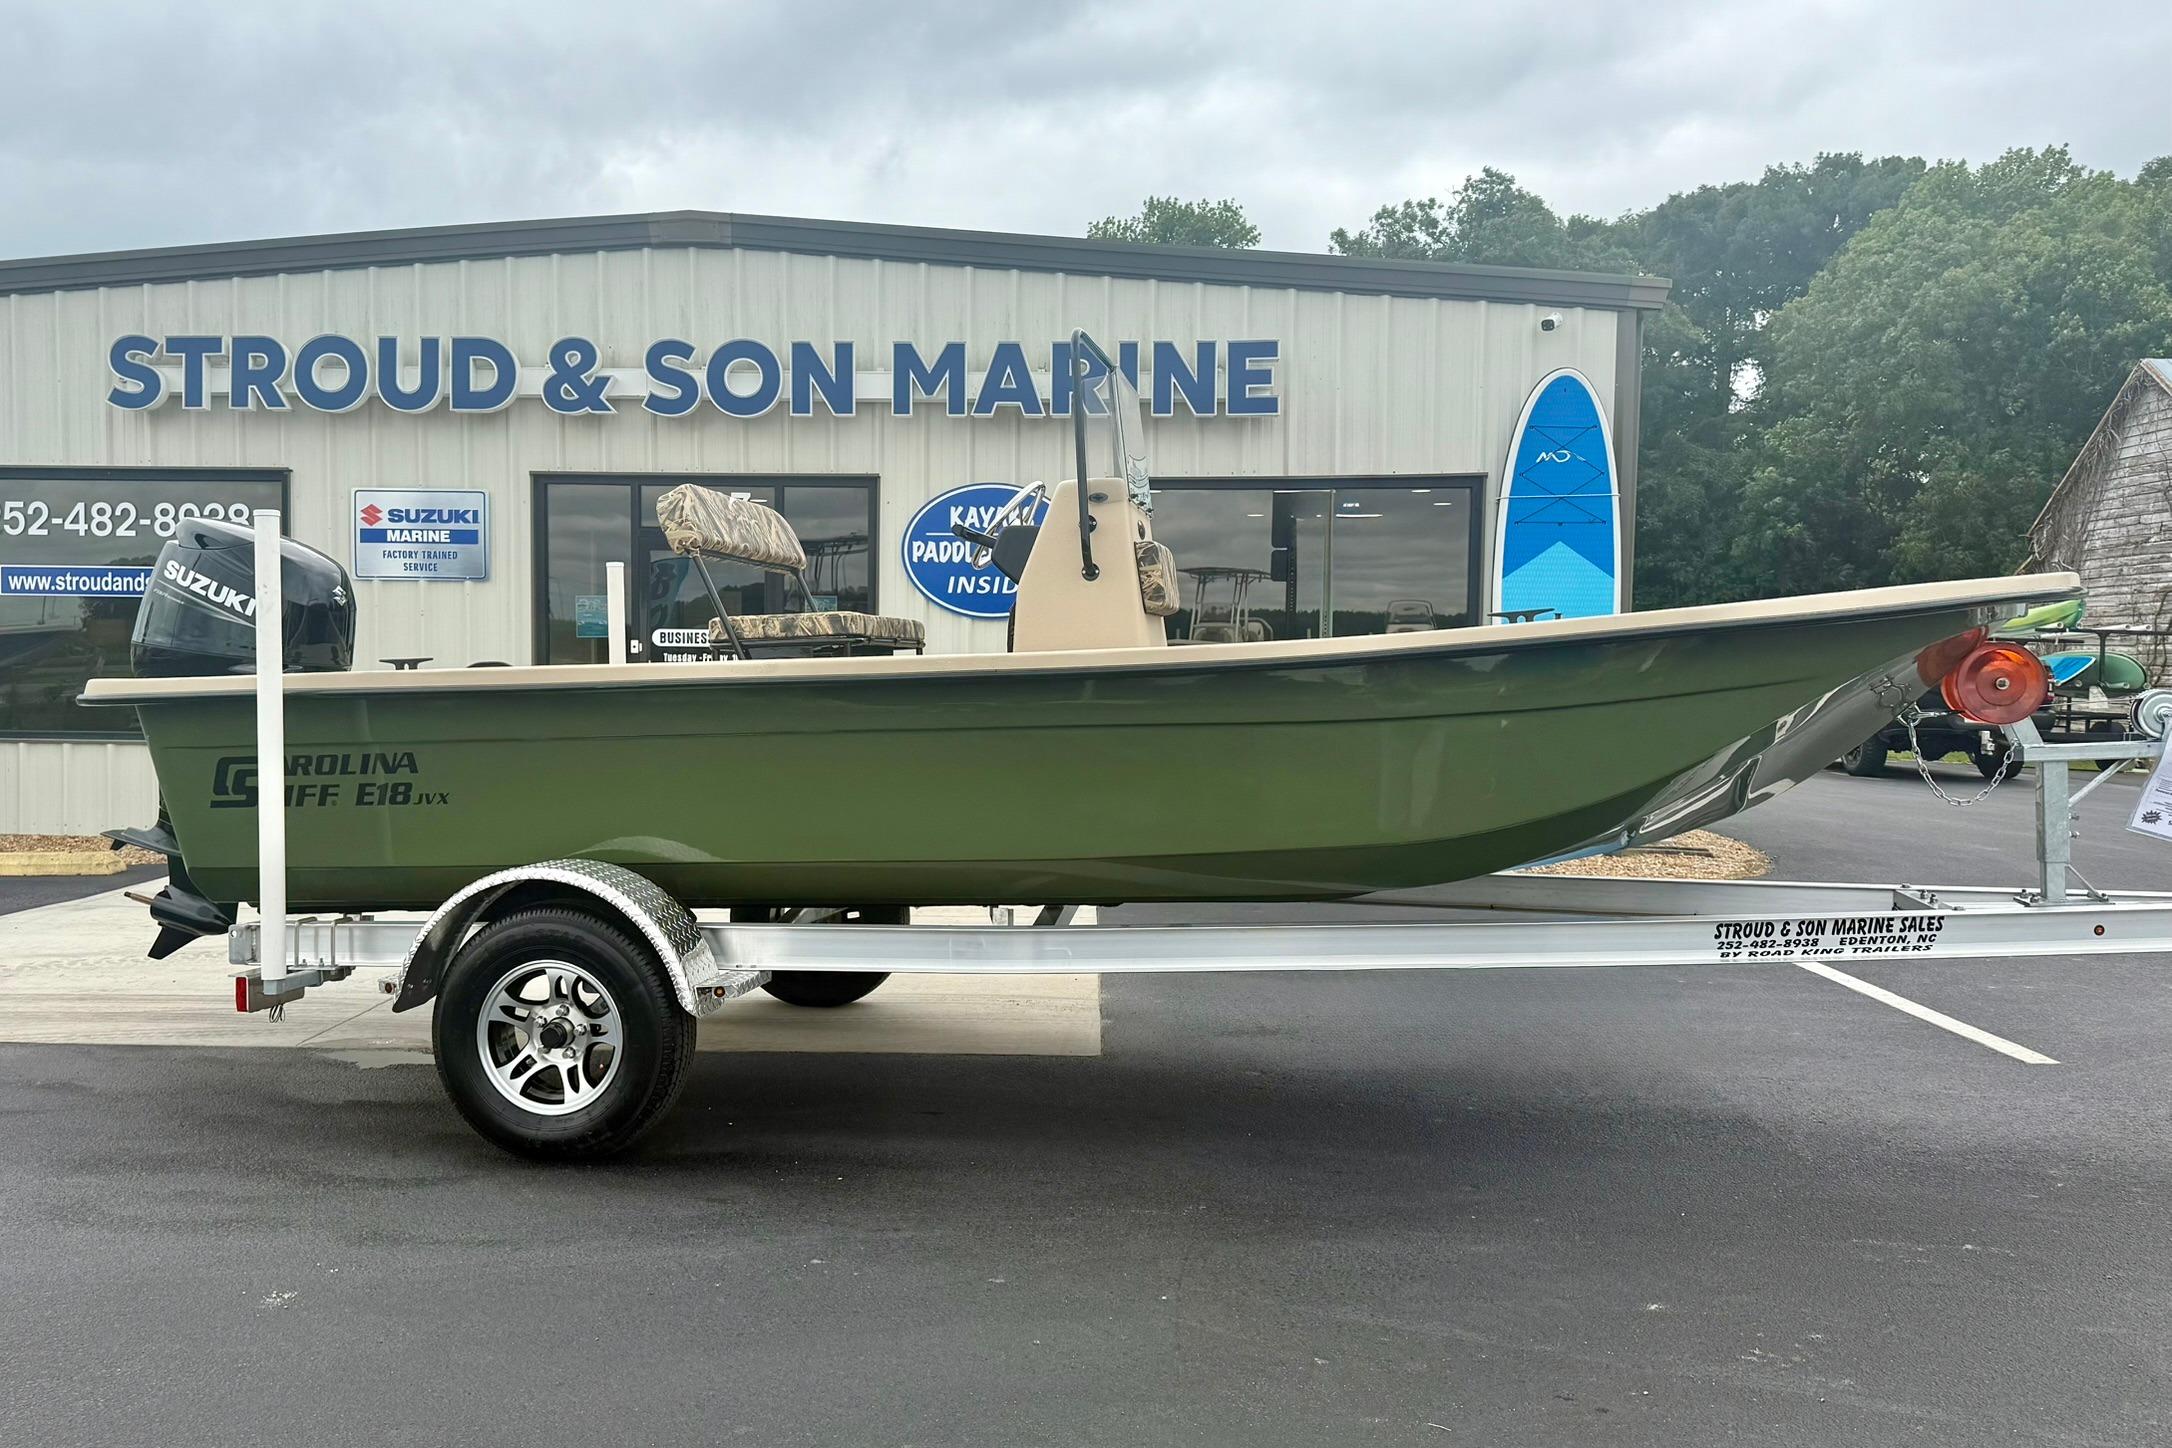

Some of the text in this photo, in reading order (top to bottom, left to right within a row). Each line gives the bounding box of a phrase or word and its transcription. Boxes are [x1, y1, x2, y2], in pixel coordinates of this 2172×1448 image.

[106, 333, 1280, 418] STROUD & SON MARINE
[0, 500, 249, 538] 52-482-88
[387, 508, 480, 524] SUZUKI
[386, 529, 451, 543] MARINE
[382, 550, 458, 560] FACTORY TRAINED
[403, 562, 438, 572] SERVICE
[8, 571, 150, 592] www.stroudand
[163, 559, 256, 617] SUZUKI
[947, 575, 1019, 594] INSID
[659, 631, 711, 644] BUSINES
[355, 783, 413, 806] E18
[413, 793, 450, 805] JVX
[1714, 915, 1945, 940] STROUD & SON MARINE SALES
[1717, 933, 1937, 950] 252-482-8938 EDENTON, NC
[1748, 949, 1795, 958] ROAD
[1801, 947, 1845, 956] KING
[1851, 944, 1934, 954] TRAILERS
